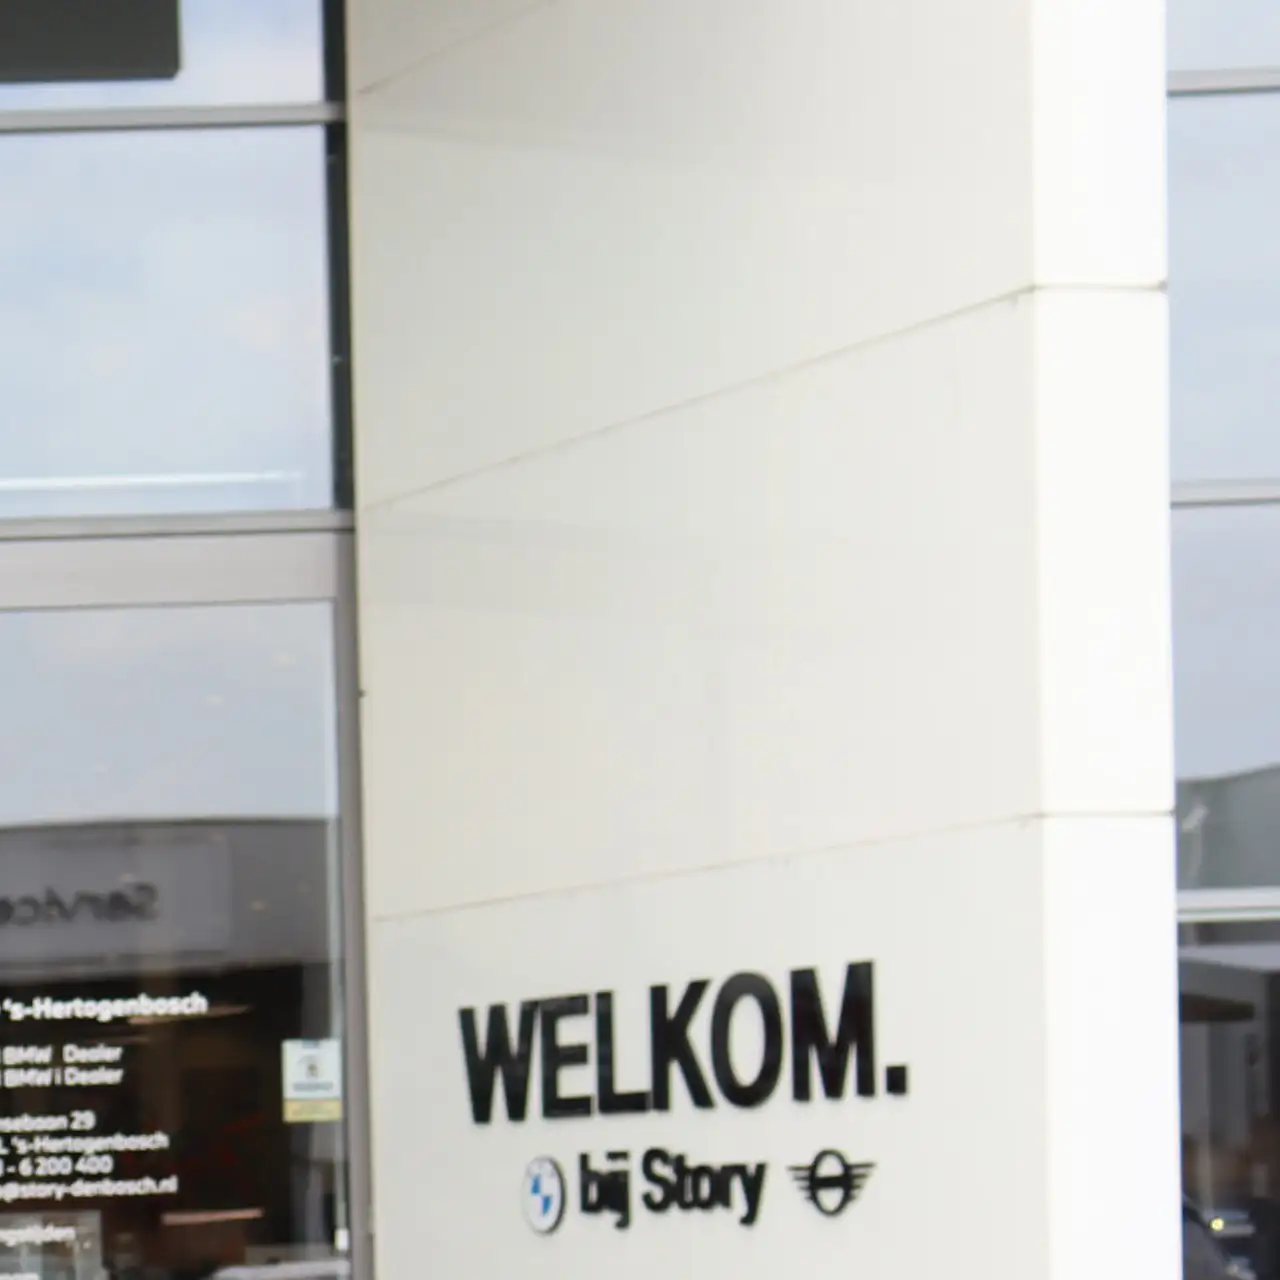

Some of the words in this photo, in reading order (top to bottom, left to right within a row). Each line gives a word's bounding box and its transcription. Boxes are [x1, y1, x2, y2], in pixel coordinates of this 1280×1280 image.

[458, 960, 908, 1125] WELKOM.
[2, 1045, 52, 1064] BMW
[62, 1043, 123, 1063] Dealer
[3, 1068, 52, 1087] BMW
[64, 1066, 124, 1085] Dealer
[35, 1156, 72, 1176] 200
[74, 1155, 114, 1174] 400
[580, 1151, 631, 1229] bij
[641, 1147, 767, 1227] Story
